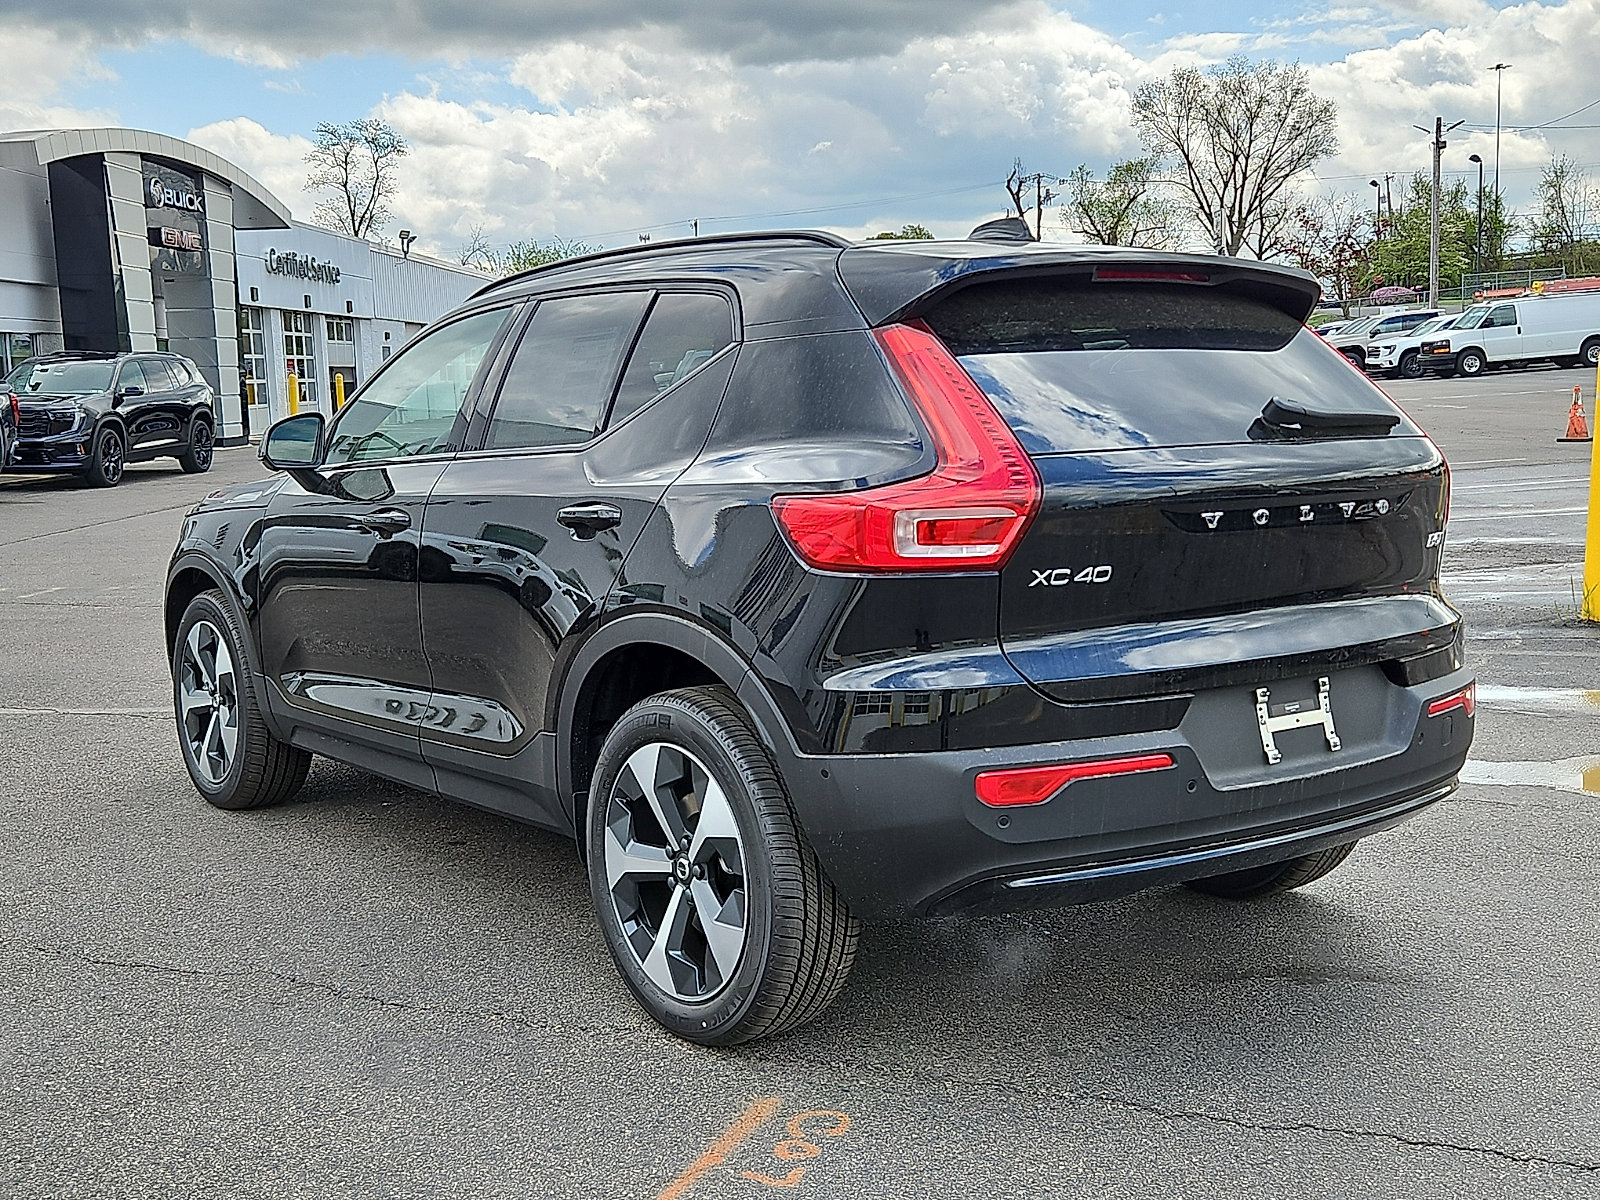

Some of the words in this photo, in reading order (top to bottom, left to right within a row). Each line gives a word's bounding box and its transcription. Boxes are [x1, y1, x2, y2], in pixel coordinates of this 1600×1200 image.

[164, 188, 204, 213] BUICK
[162, 227, 203, 251] GMC
[266, 248, 309, 279] Certified
[309, 256, 341, 285] Service
[1201, 498, 1390, 529] VOLVO
